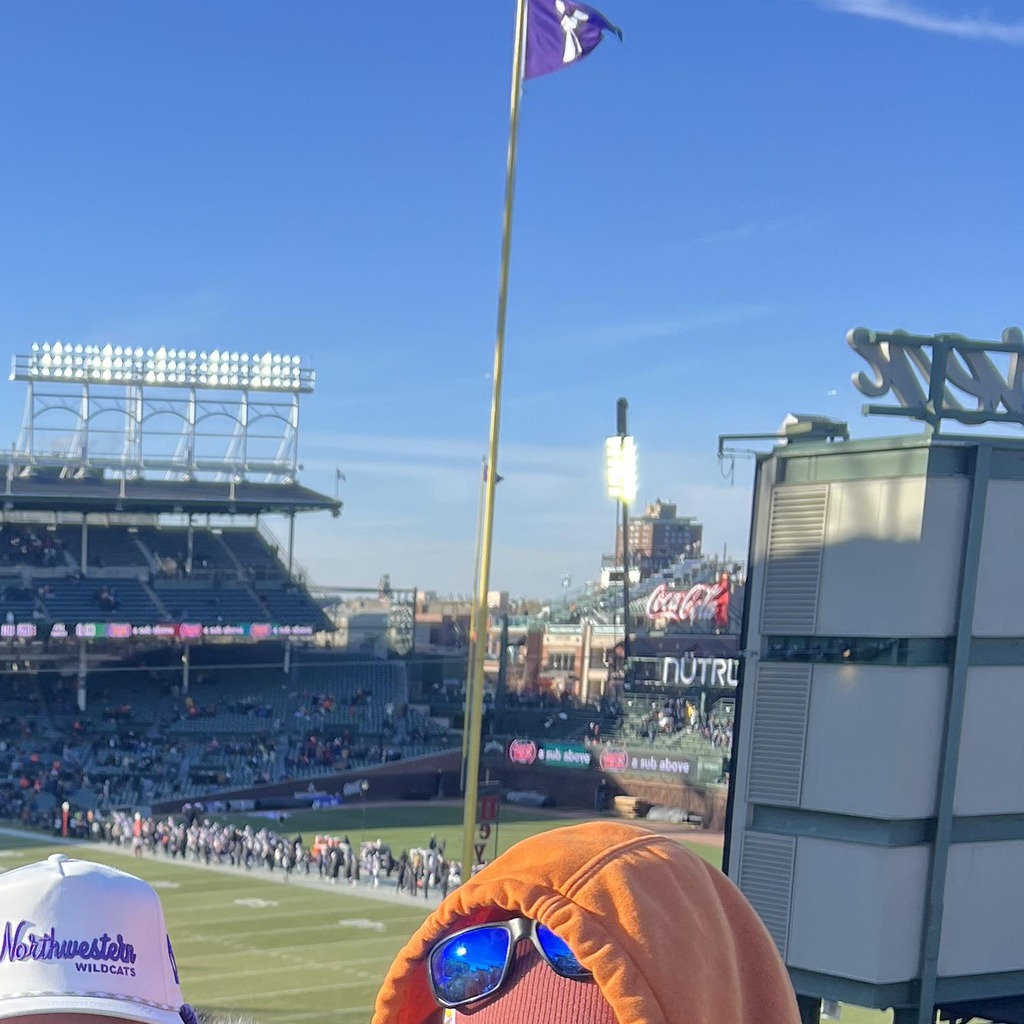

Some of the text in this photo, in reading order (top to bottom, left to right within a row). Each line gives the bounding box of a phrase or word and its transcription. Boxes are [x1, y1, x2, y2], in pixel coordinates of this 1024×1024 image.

[546, 748, 561, 761] sub
[563, 749, 591, 764] above
[640, 755, 656, 771] sub
[659, 757, 689, 773] above
[75, 962, 136, 977] WILDCATS
